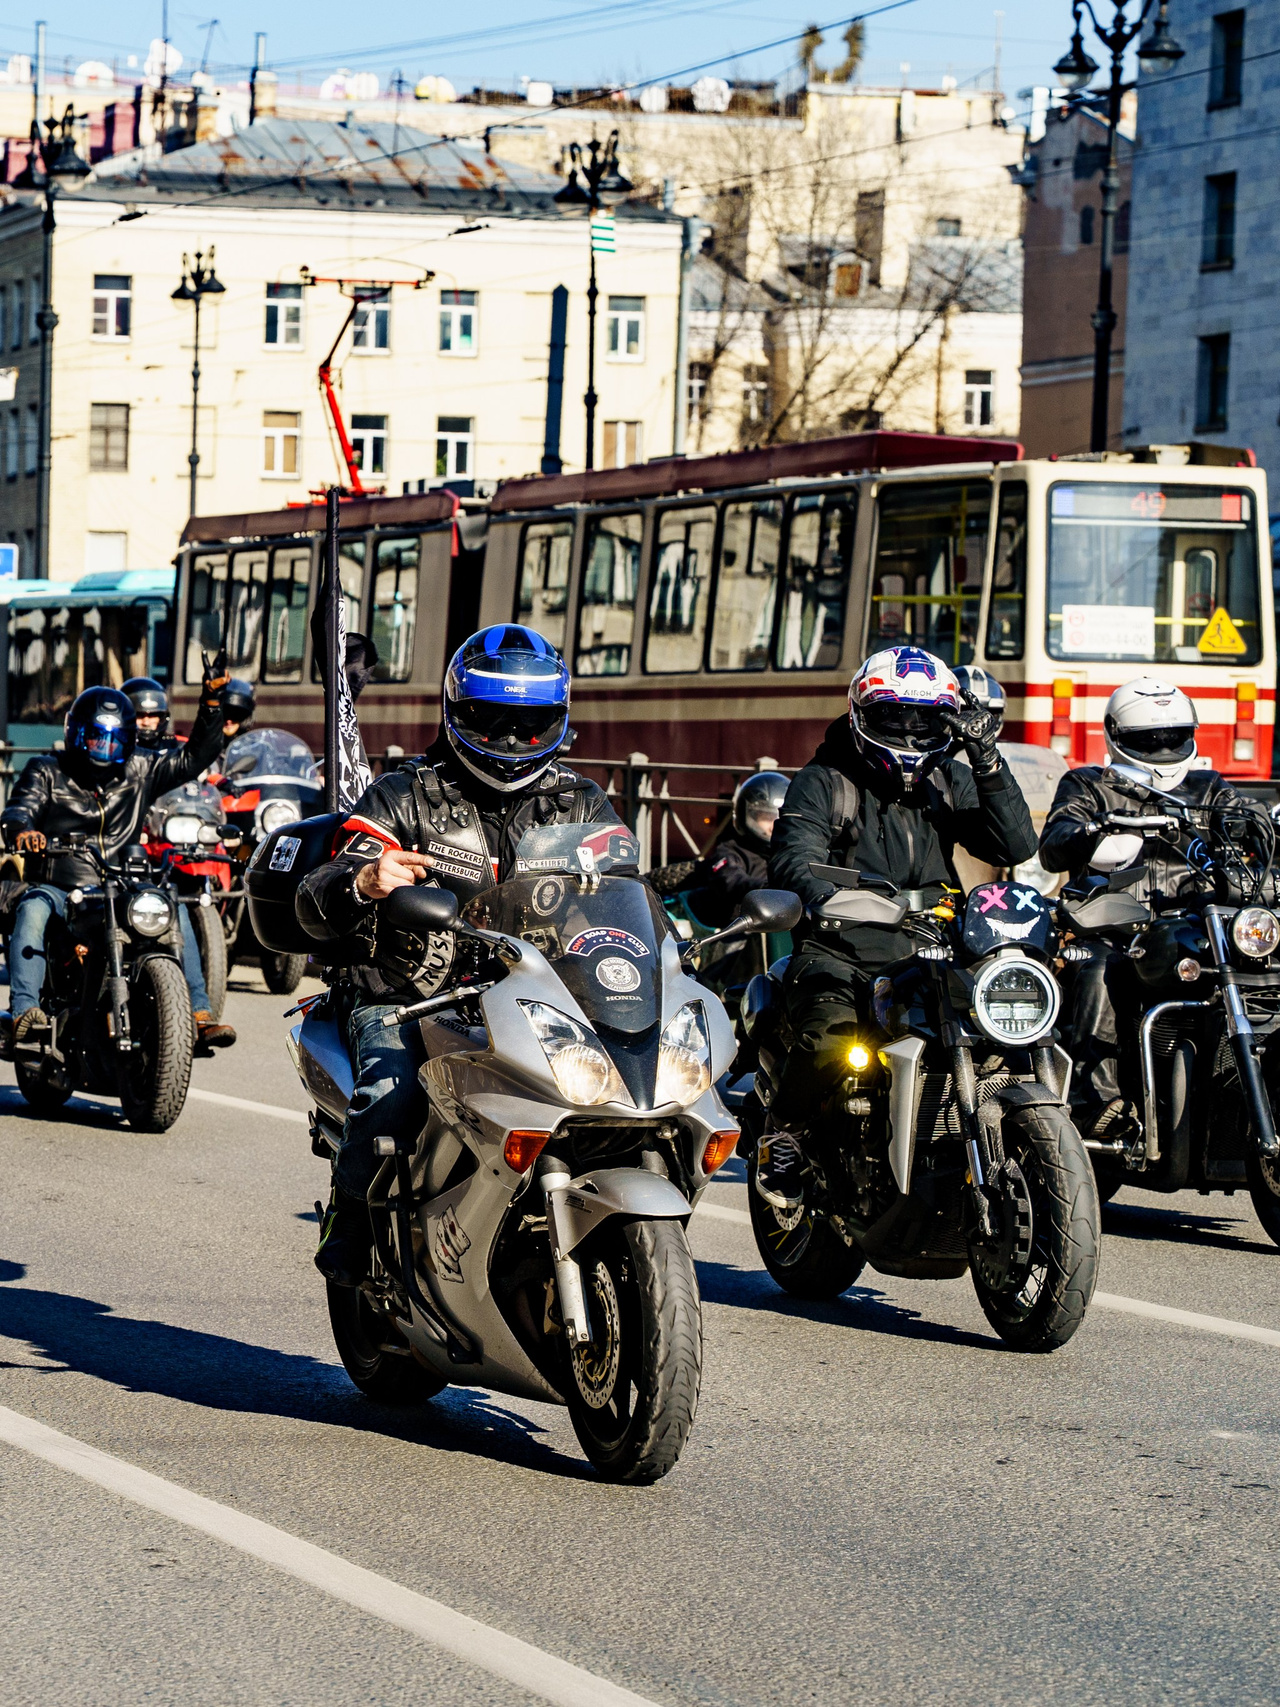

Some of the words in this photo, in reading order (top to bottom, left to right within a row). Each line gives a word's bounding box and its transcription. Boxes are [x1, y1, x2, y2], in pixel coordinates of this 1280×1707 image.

[1130, 491, 1166, 518] 49
[903, 689, 932, 697] AIROH
[429, 843, 447, 855] THE
[447, 847, 482, 864] ROCKERS
[432, 860, 480, 880] .PETERSBURG
[572, 937, 586, 951] ONE
[584, 930, 607, 940] ROAD
[608, 930, 627, 939] ONE
[627, 937, 646, 952] CLUB
[433, 1015, 471, 1038] HONDA
